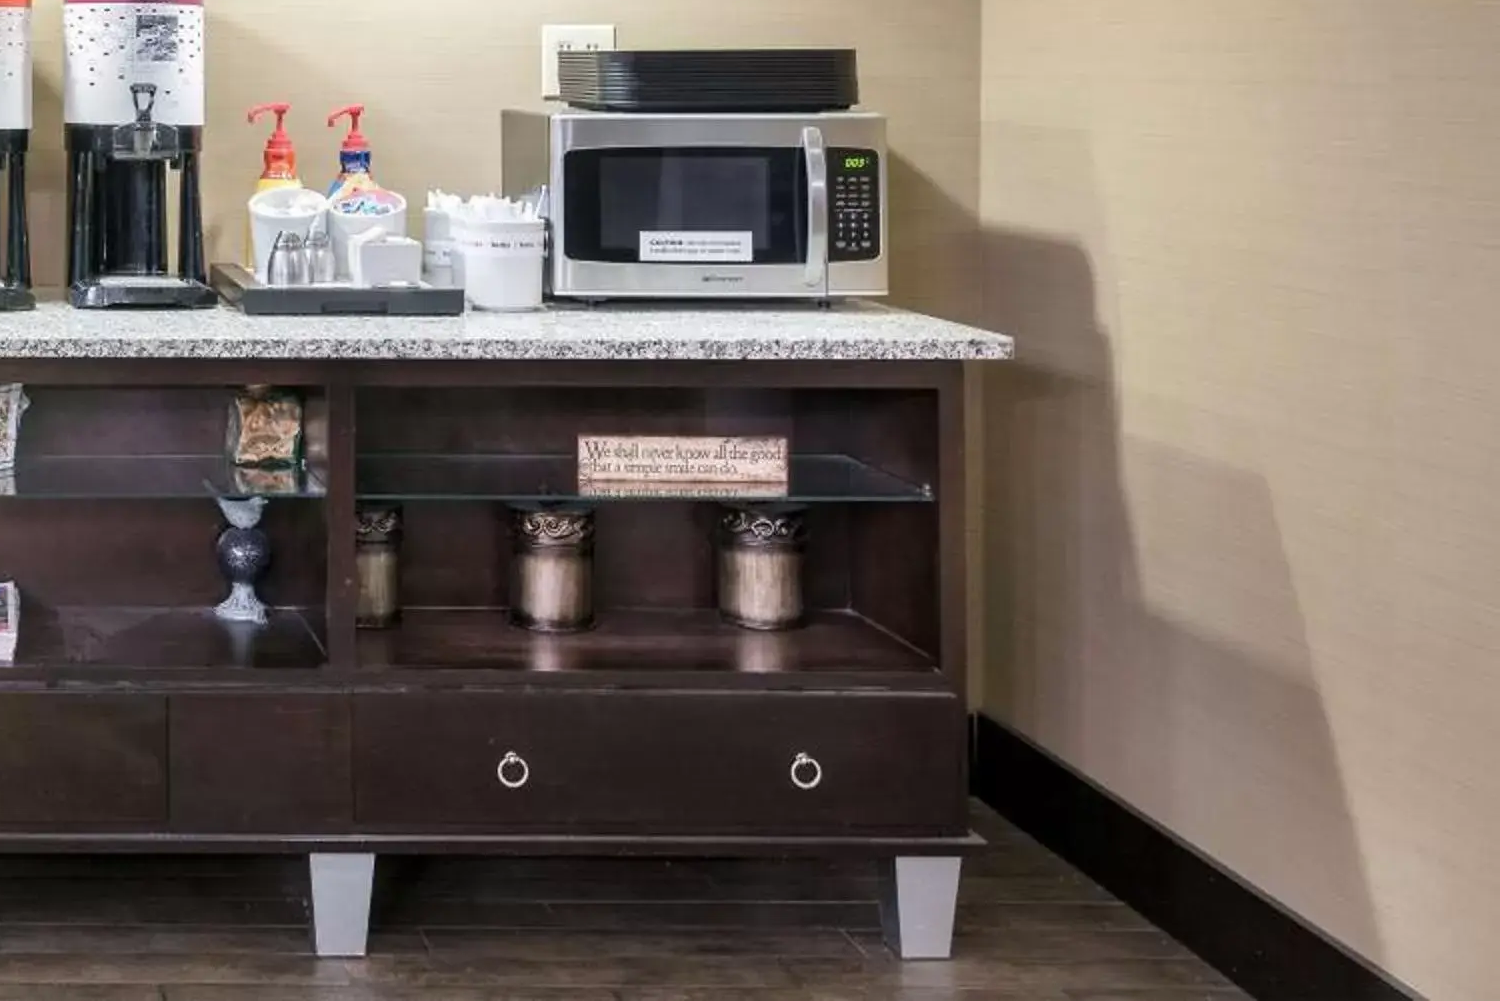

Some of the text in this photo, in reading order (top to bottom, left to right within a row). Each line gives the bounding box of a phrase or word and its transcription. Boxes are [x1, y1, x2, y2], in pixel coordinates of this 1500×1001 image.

[585, 440, 781, 464] We shall never know all the good
[590, 459, 613, 473] that
[614, 463, 621, 473] a
[697, 464, 717, 474] can
